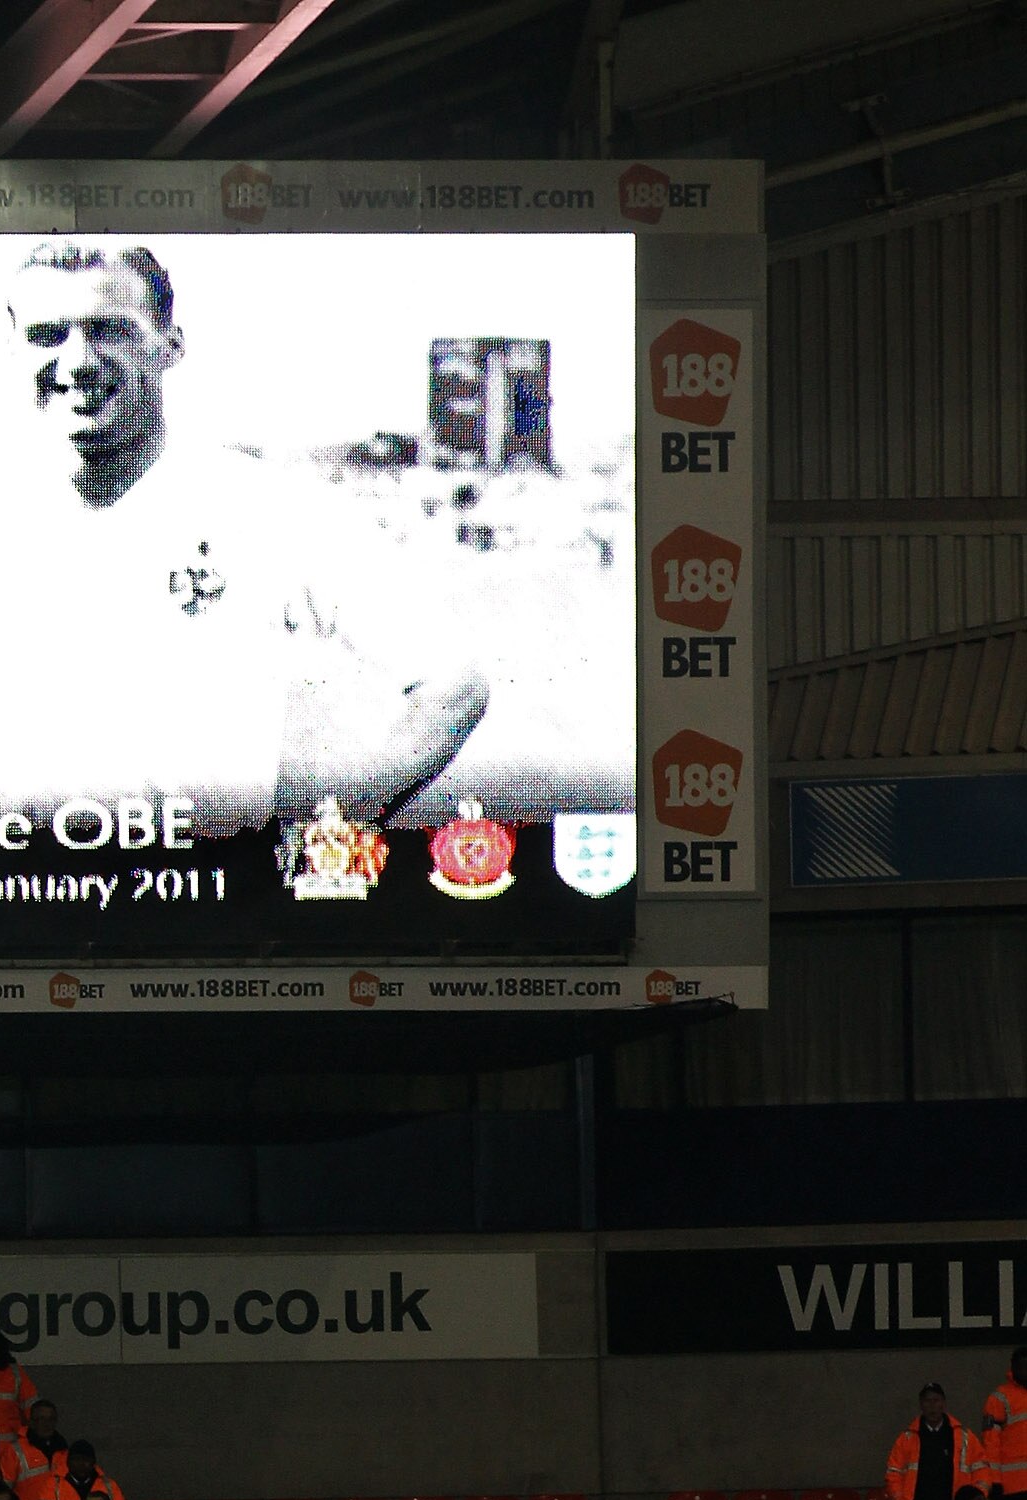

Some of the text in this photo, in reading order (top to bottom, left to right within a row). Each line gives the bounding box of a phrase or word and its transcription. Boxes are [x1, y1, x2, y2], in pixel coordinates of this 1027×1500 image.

[339, 183, 595, 210] www.188BET.com
[662, 354, 734, 399] 188
[661, 431, 735, 473] BET
[664, 559, 735, 603] 188
[662, 637, 736, 679] BET
[665, 763, 736, 807] 188
[52, 796, 195, 849] OBE
[663, 841, 737, 883] BET
[130, 867, 226, 902] 2011
[129, 977, 325, 998] www.188BET.com
[429, 976, 622, 998] www.188BET.com
[777, 1260, 1027, 1332] WILLI
